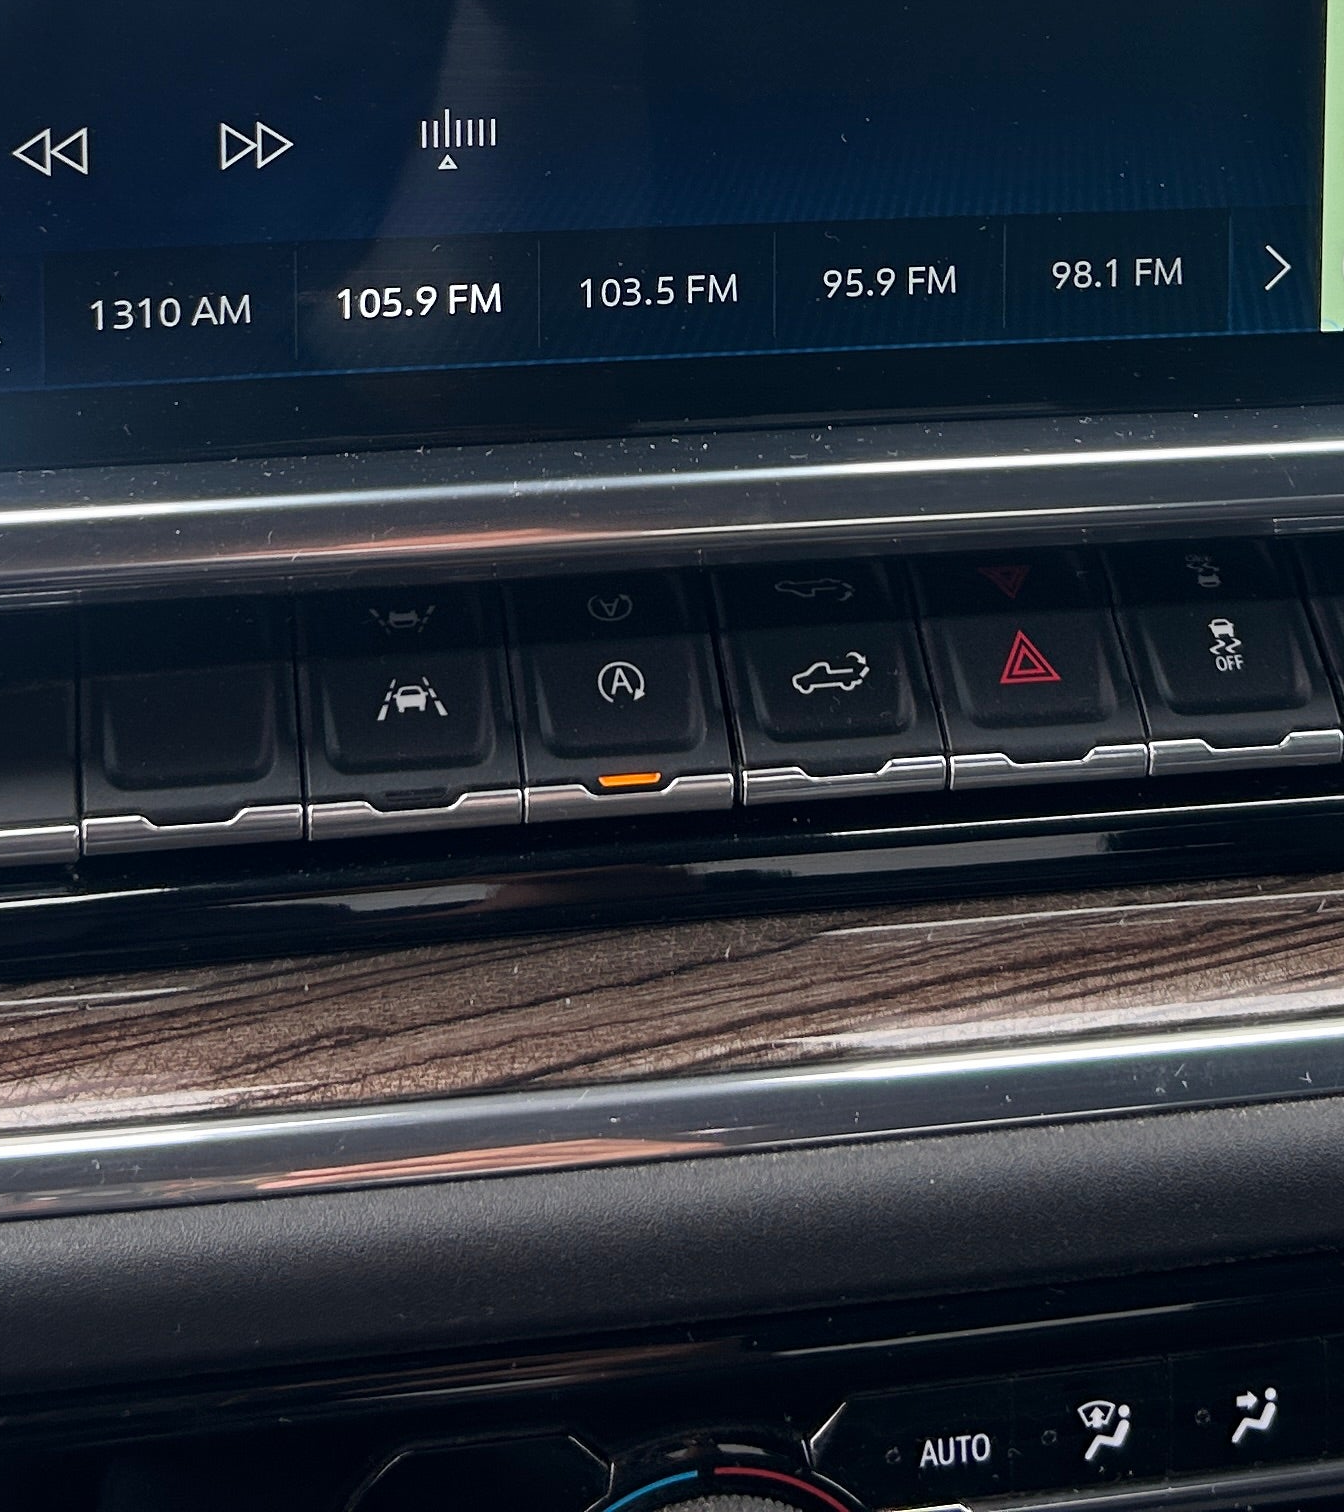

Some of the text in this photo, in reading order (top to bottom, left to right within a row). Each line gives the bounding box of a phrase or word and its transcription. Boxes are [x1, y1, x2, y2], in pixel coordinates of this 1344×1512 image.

[580, 273, 739, 309] 103.5 FM
[823, 265, 957, 299] 95.9 FM
[1052, 257, 1184, 290] 98.1 FM
[89, 294, 252, 331] 1310 AM
[336, 282, 502, 321] 105.9 FM
[1215, 653, 1244, 672] OFF
[919, 1433, 991, 1468] AUTO
